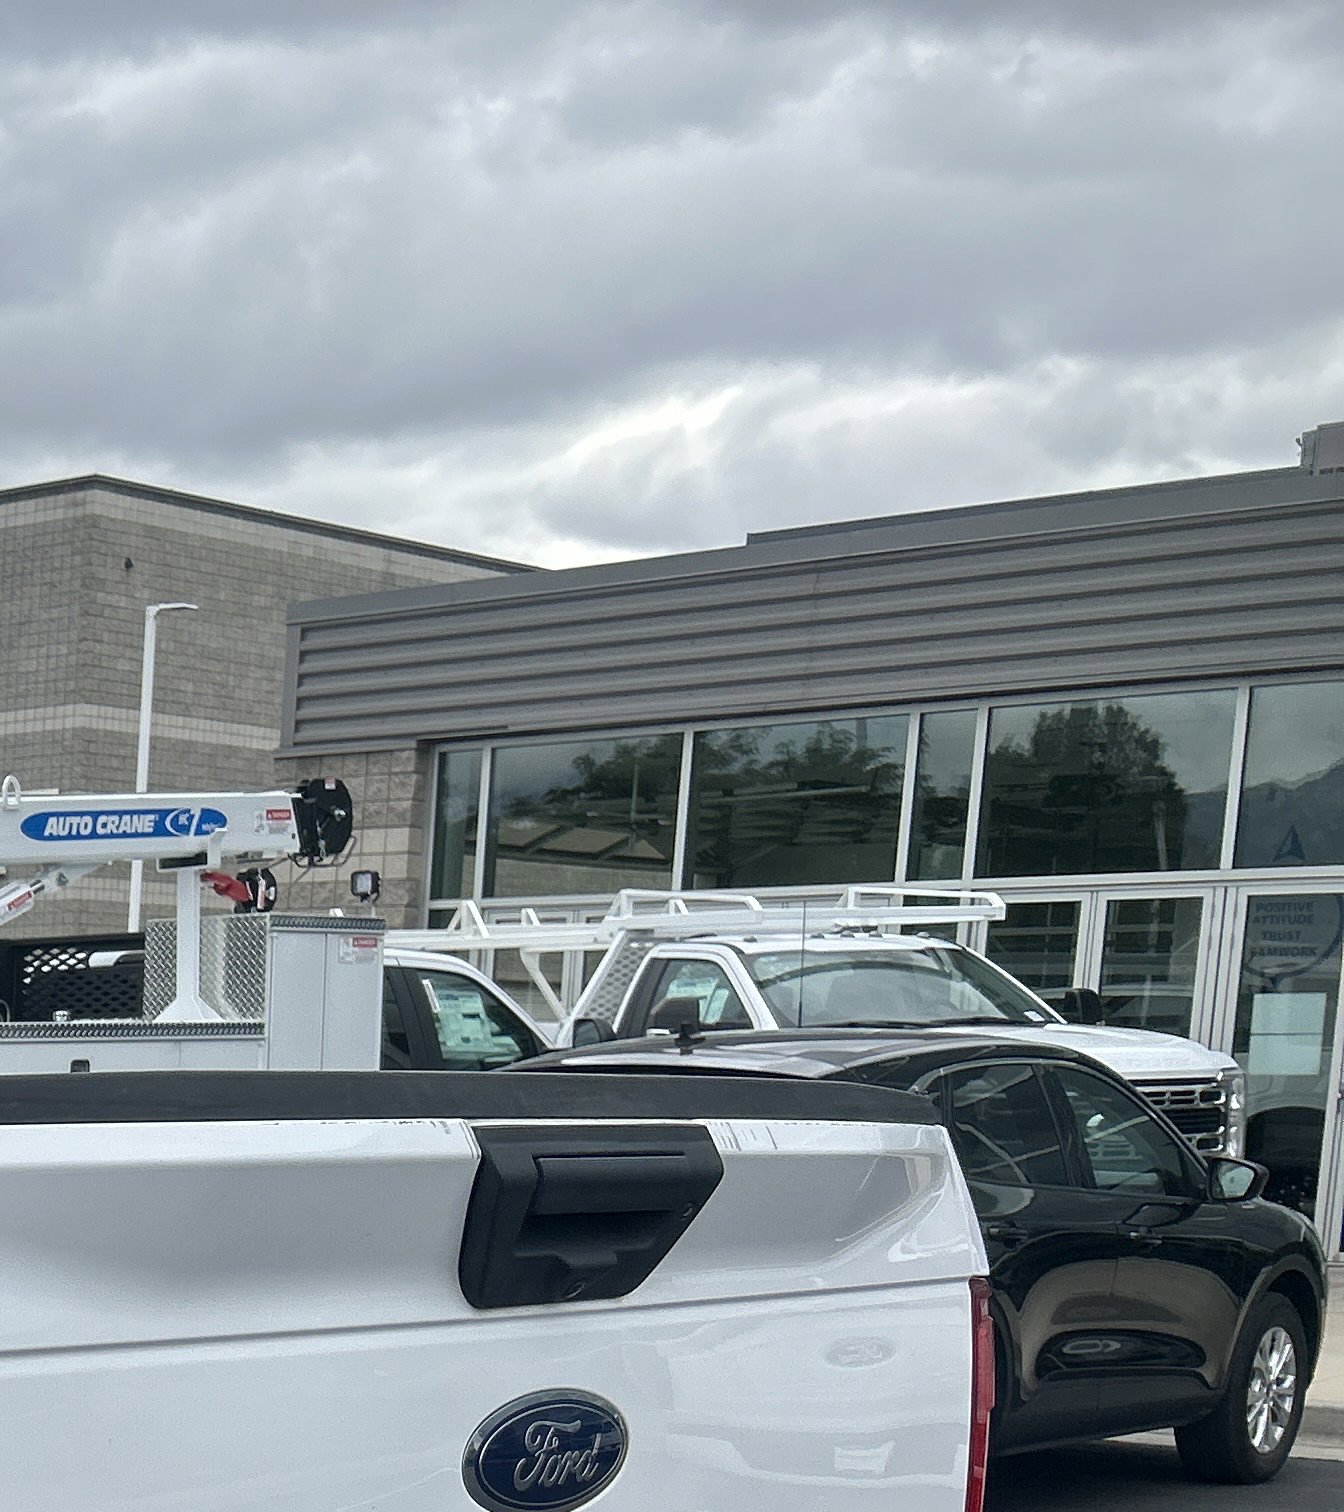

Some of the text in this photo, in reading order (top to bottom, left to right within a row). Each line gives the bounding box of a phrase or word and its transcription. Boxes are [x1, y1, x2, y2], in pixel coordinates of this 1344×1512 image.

[43, 813, 156, 837] AUTO CRANE
[1256, 902, 1313, 912] POSITIVE
[1253, 914, 1314, 924] ATTITUDE
[514, 1419, 601, 1492] Ford
